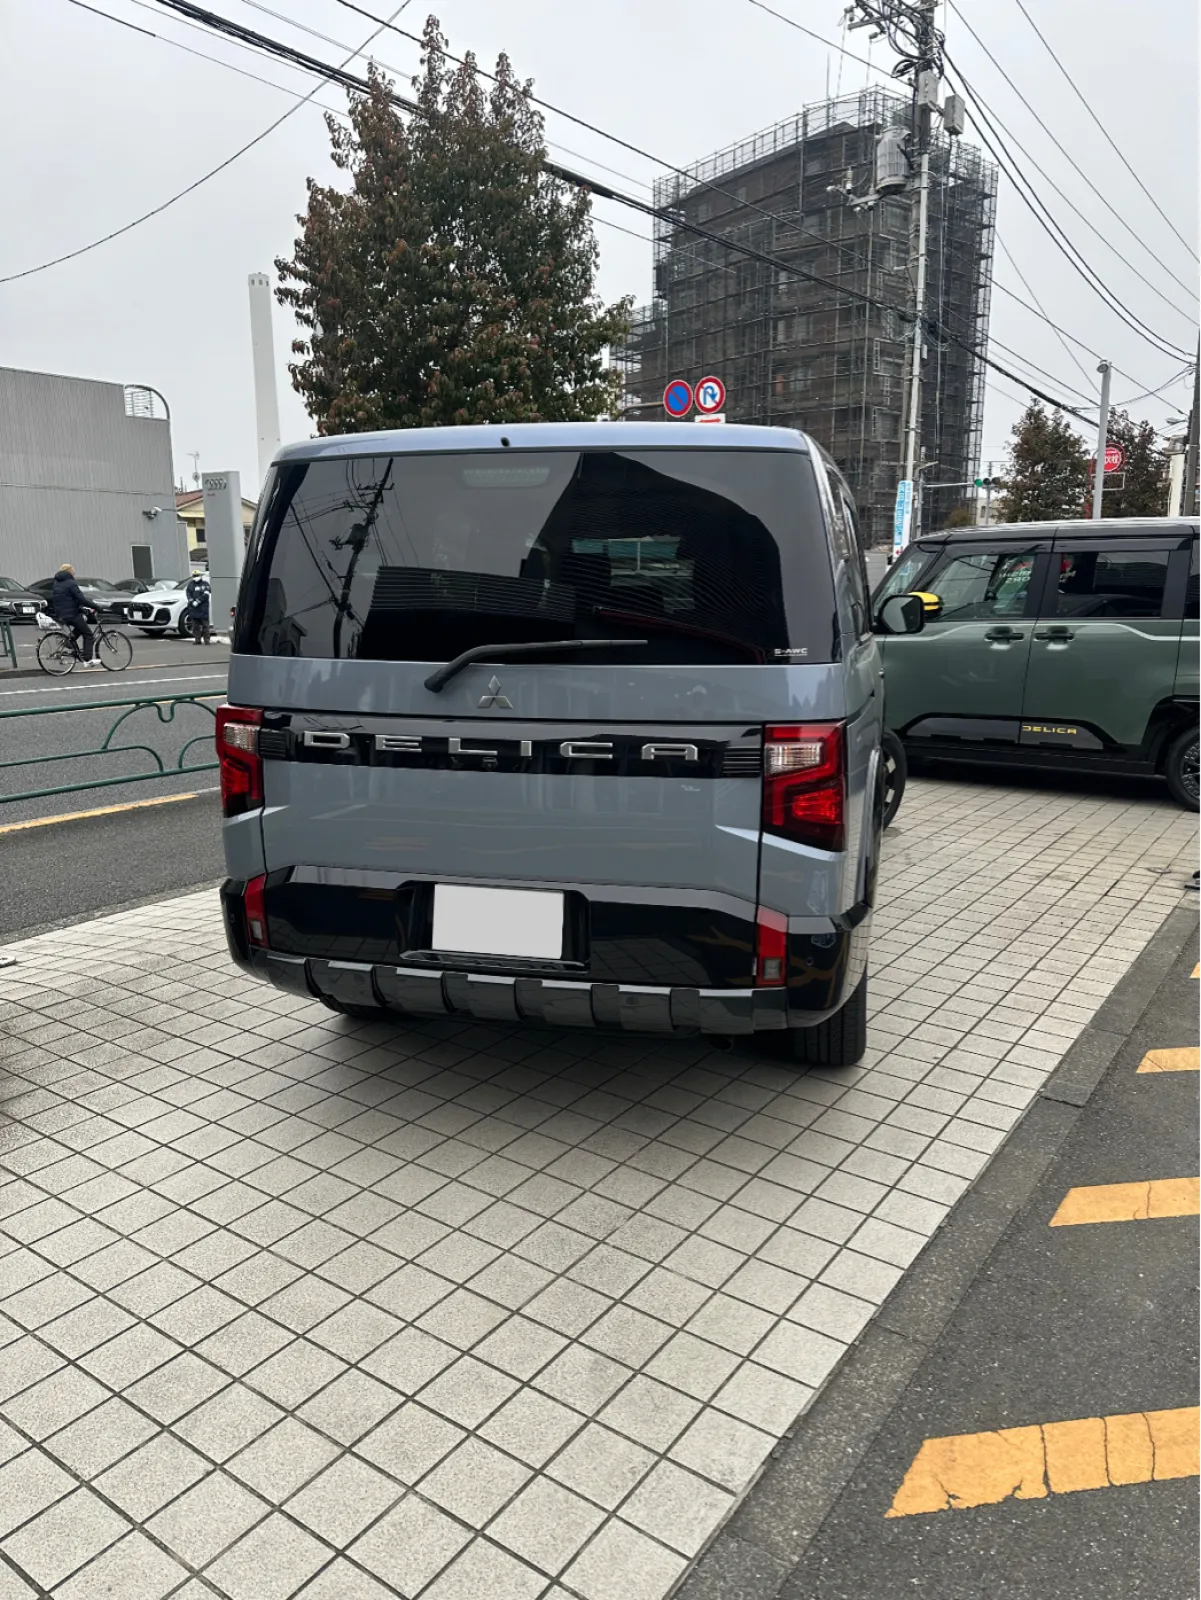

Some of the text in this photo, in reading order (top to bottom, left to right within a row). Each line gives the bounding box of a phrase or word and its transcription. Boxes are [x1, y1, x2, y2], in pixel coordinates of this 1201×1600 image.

[773, 648, 808, 656] S-AWC
[1022, 725, 1077, 734] DELICA
[303, 730, 698, 760] DELICA
